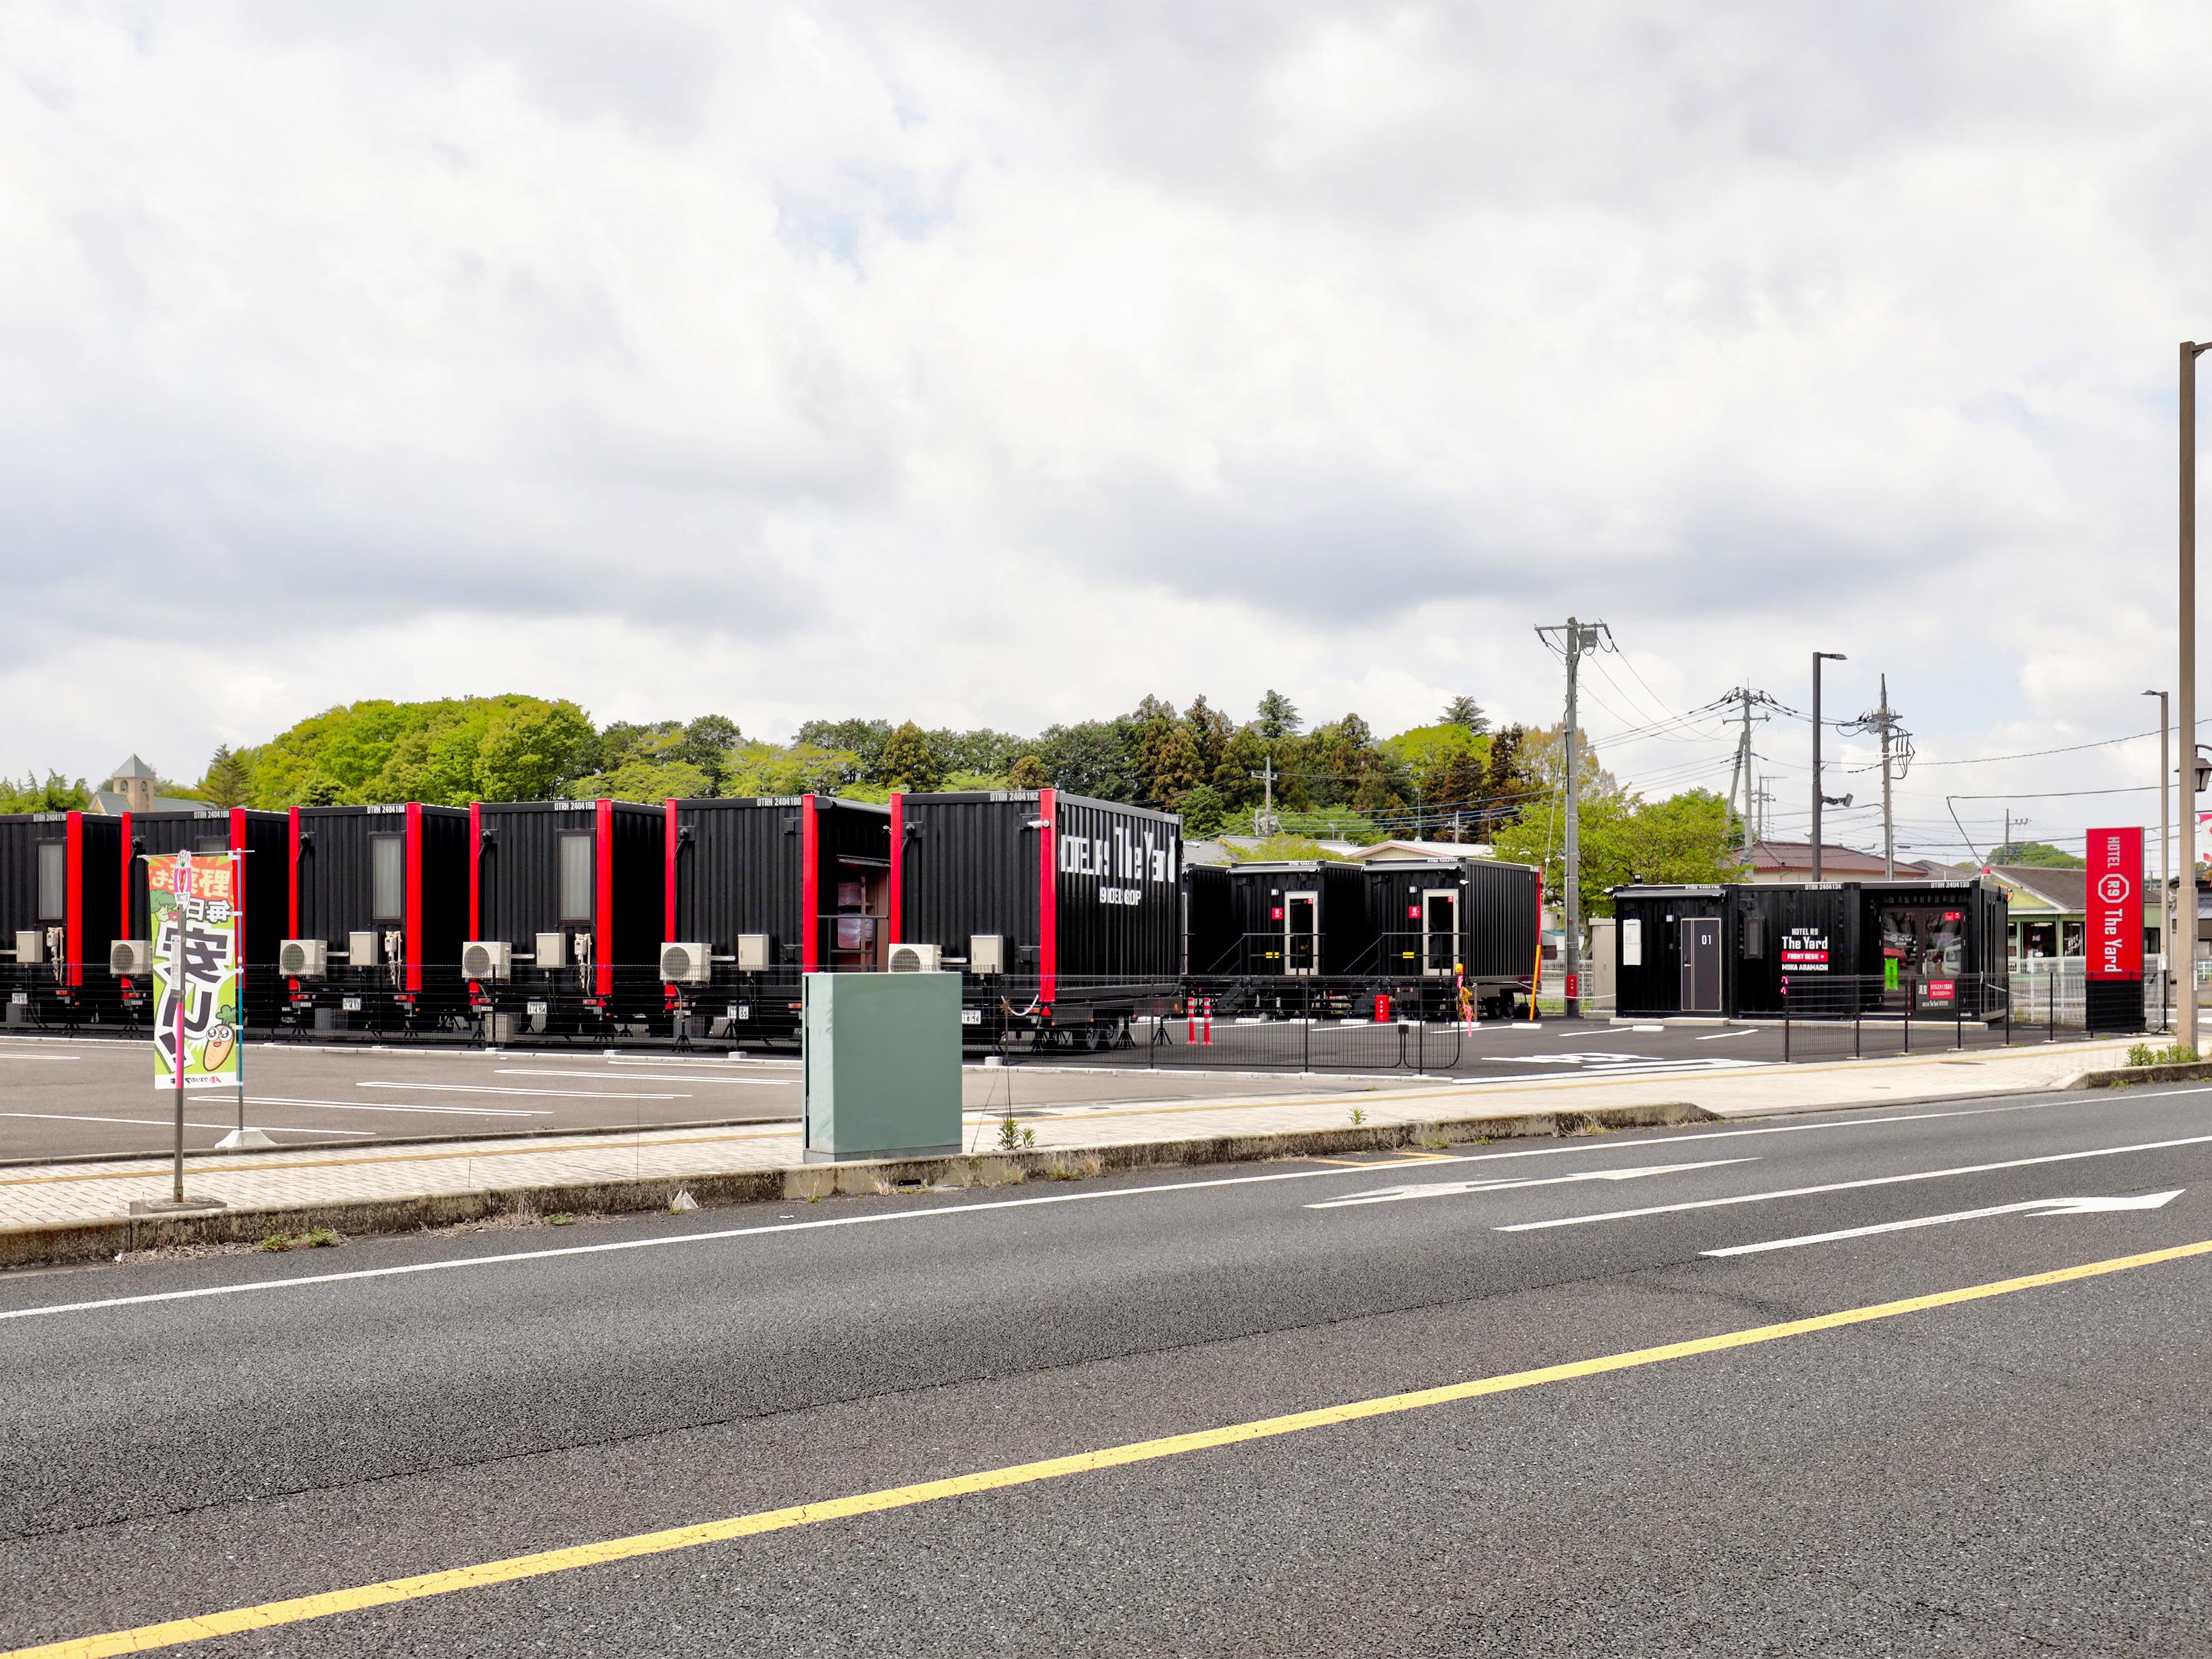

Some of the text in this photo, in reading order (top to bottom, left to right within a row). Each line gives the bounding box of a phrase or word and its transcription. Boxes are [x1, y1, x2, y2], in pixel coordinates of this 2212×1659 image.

[1115, 826, 1142, 879] The
[1144, 831, 1176, 883] Yard
[2107, 836, 2121, 869] HOTEL
[2107, 880, 2121, 896] R9
[1701, 935, 1711, 945] 01
[1782, 936, 1828, 949] The Yard
[2104, 908, 2123, 972] The Yard
